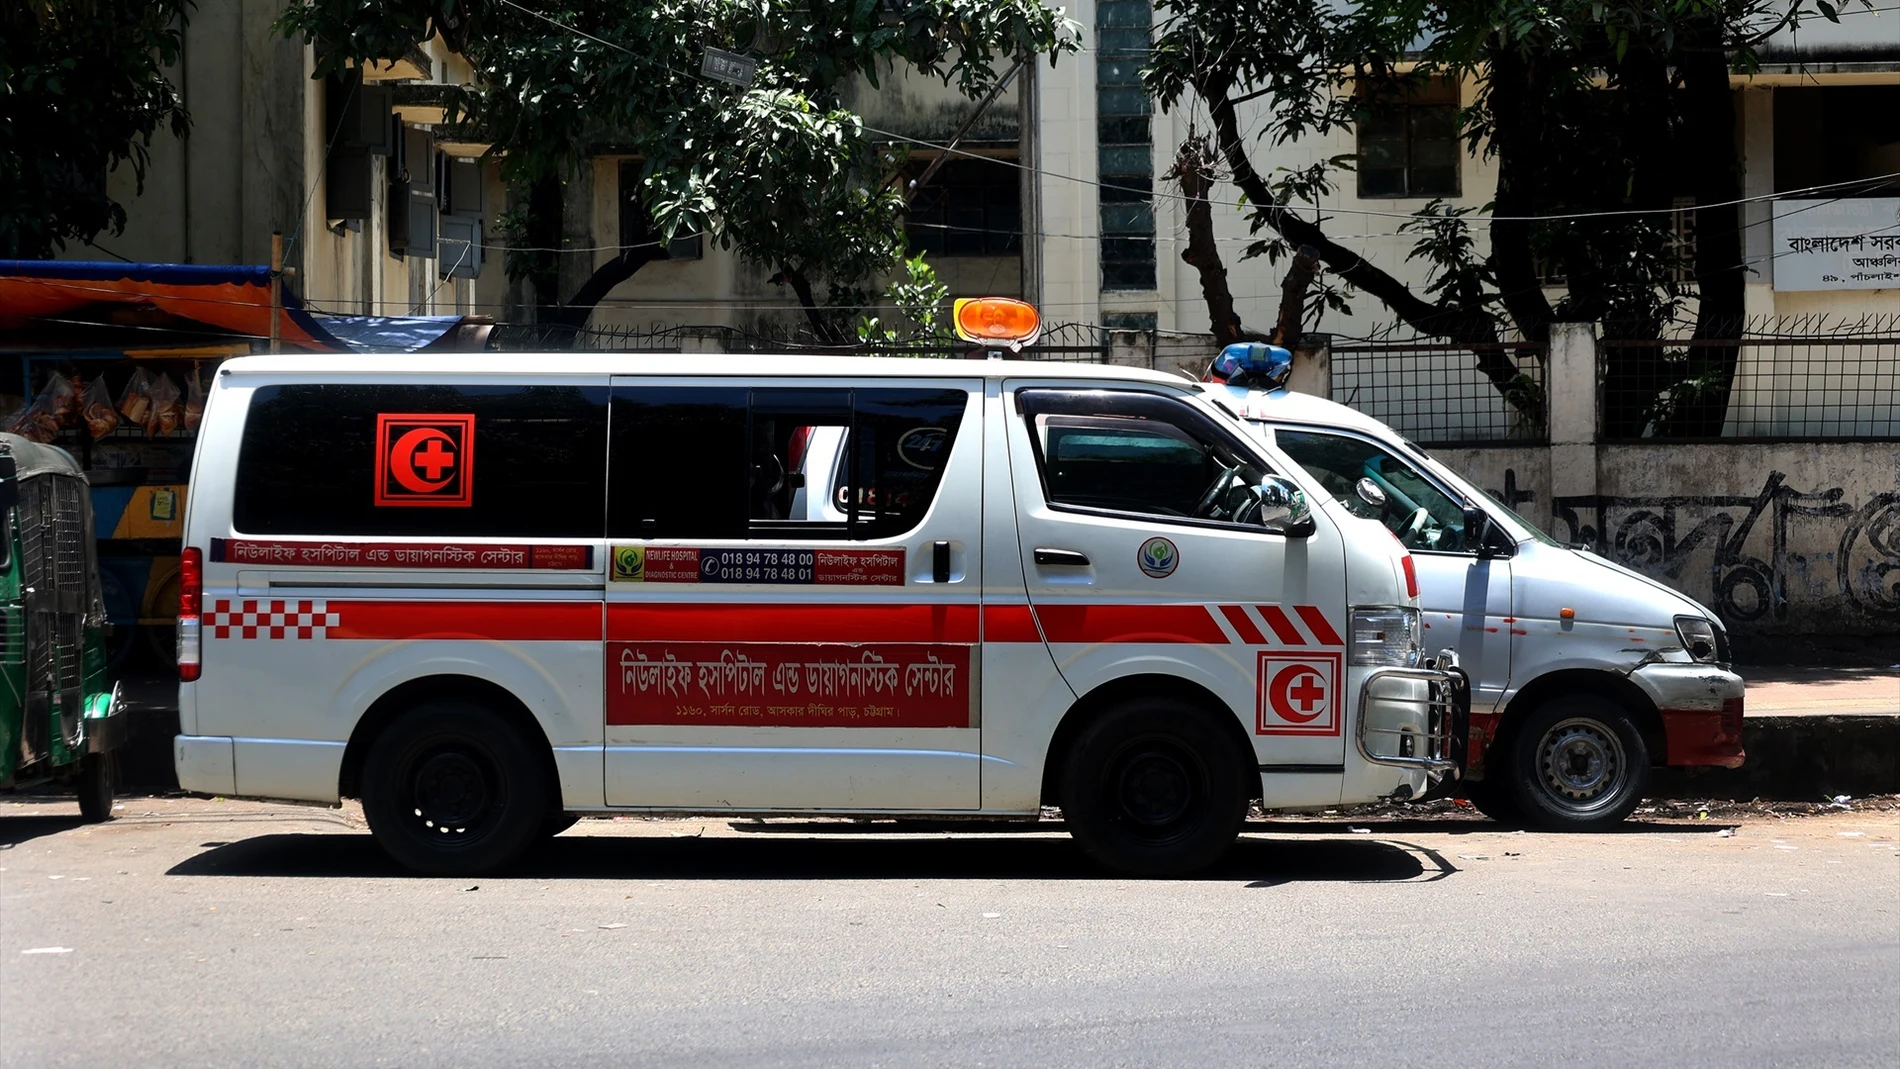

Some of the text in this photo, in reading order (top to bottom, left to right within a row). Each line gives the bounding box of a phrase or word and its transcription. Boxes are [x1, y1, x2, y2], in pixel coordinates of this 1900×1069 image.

[1787, 235, 1866, 254] বাংলাদেশ
[1852, 254, 1900, 268] আঞ্চলি
[233, 541, 297, 561] নিউলাইফ
[301, 544, 360, 562] হসপিটাল
[365, 549, 390, 562] এন্ড
[394, 545, 476, 564] ডায়াগনস্টিক
[481, 547, 525, 564] সেন্টার
[645, 550, 698, 561] NEWLIFE HOSPITAL
[721, 553, 813, 565] 018 94 78 48 00
[818, 553, 898, 567] নিউলাইফ হসপিটাল
[721, 568, 813, 580] 018 94 78 48 01
[818, 573, 867, 582] ডায়াগনস্টিক
[620, 648, 956, 700] নিউলাইফ হসপিটাল এন্ড ডায়াগনস্টিক সেন্টার
[676, 705, 706, 717] ১১৬০,
[710, 702, 735, 716] সার্সন
[738, 705, 763, 718] রোড,
[767, 706, 804, 717] আসকার
[807, 703, 834, 717] দীঘির
[837, 705, 860, 719] পাড়,
